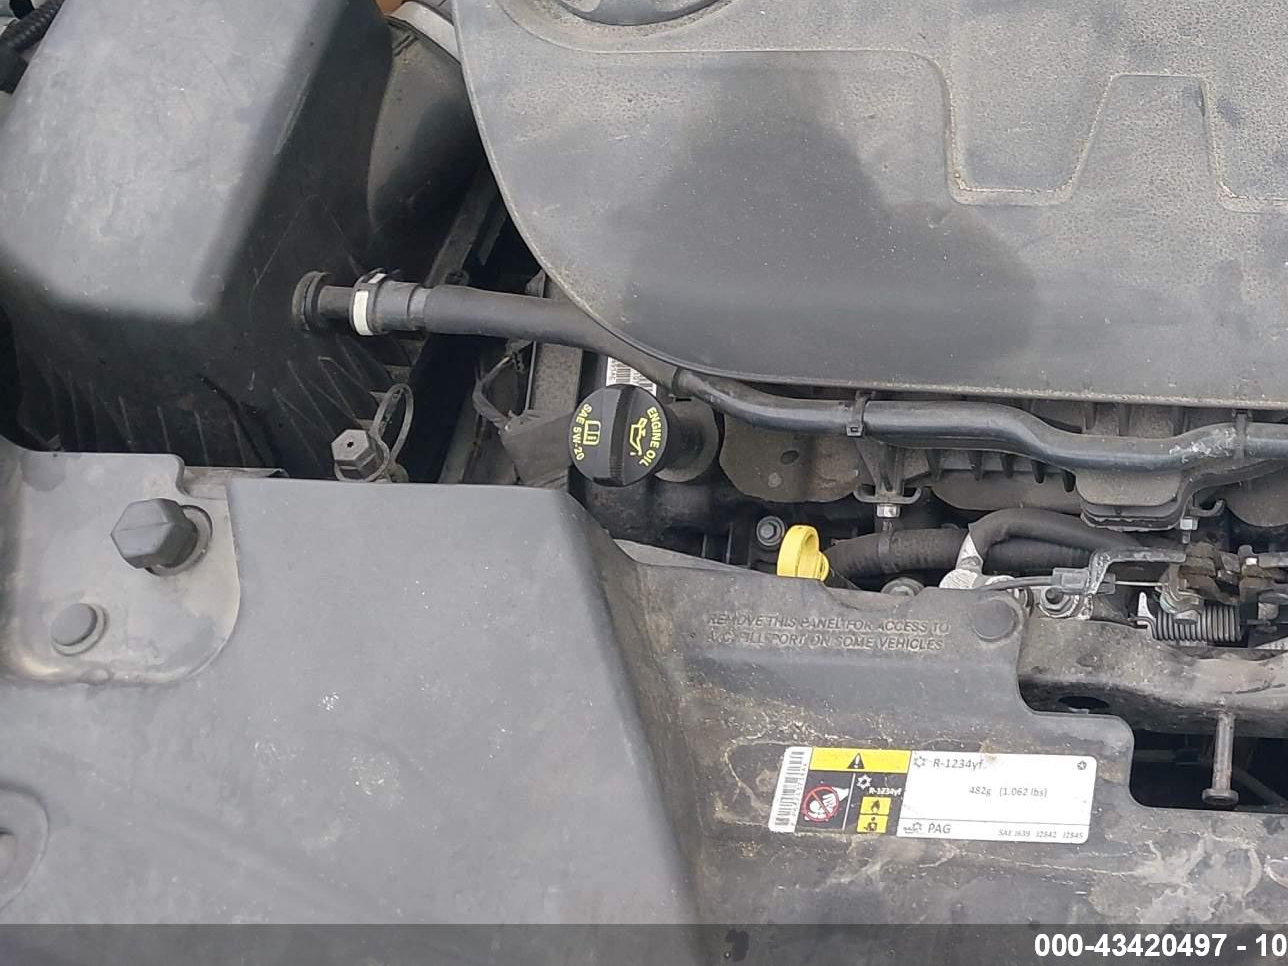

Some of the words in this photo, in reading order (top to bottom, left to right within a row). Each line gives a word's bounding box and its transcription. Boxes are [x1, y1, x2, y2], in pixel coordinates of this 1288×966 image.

[576, 404, 592, 424] SAE
[646, 406, 662, 449] ENGINE
[573, 427, 585, 460] 5W-20
[639, 449, 657, 467] OIL
[708, 615, 763, 628] REMOVE
[767, 617, 797, 629] THIS
[801, 618, 842, 631] PANEL
[846, 619, 872, 631] FOR
[877, 620, 928, 633] ACCESS
[932, 622, 951, 634] TO
[836, 635, 874, 648] SOME
[879, 636, 944, 651] VEHICLES
[933, 757, 984, 771] R-1234yf
[928, 822, 951, 834] PAG
